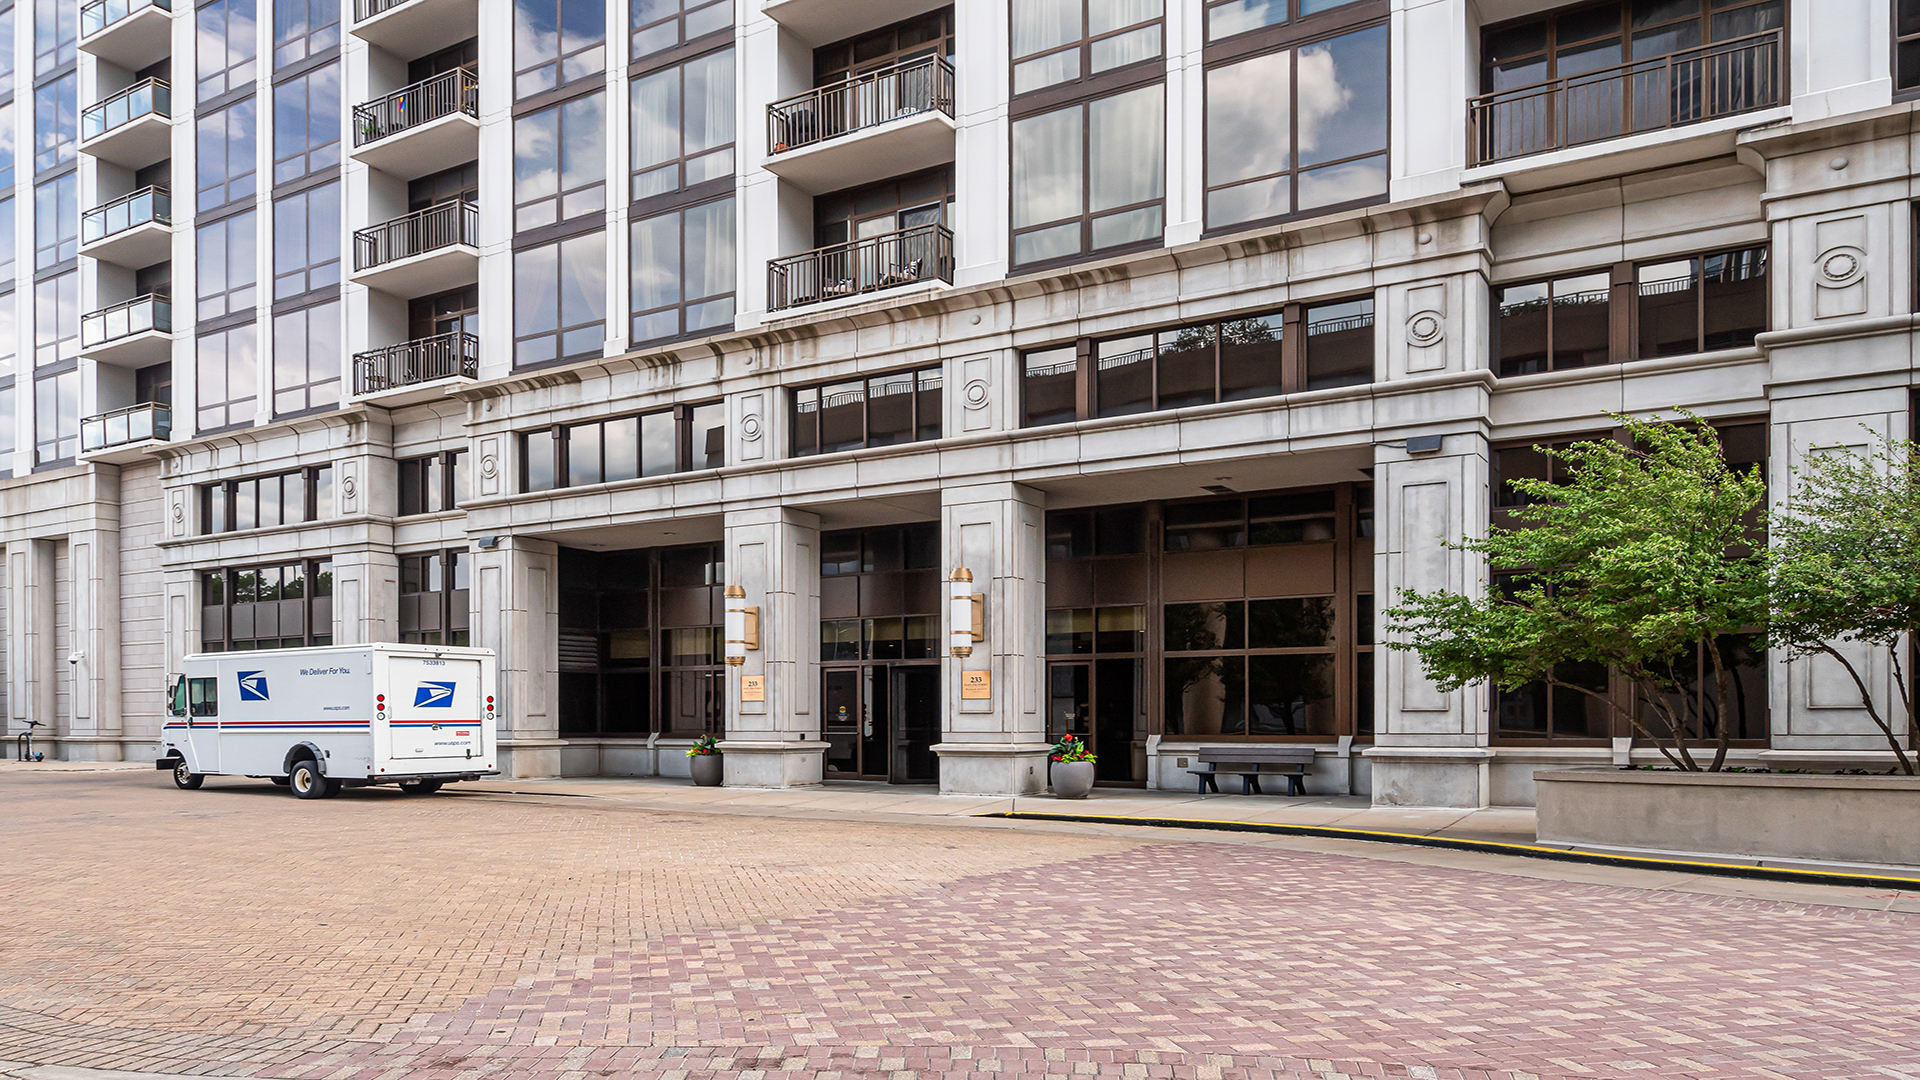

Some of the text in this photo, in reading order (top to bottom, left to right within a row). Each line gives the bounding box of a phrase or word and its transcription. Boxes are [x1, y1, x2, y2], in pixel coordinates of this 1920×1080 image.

[299, 668, 308, 676] We
[309, 668, 328, 676] Deliver
[329, 667, 338, 675] For
[970, 676, 982, 684] 233
